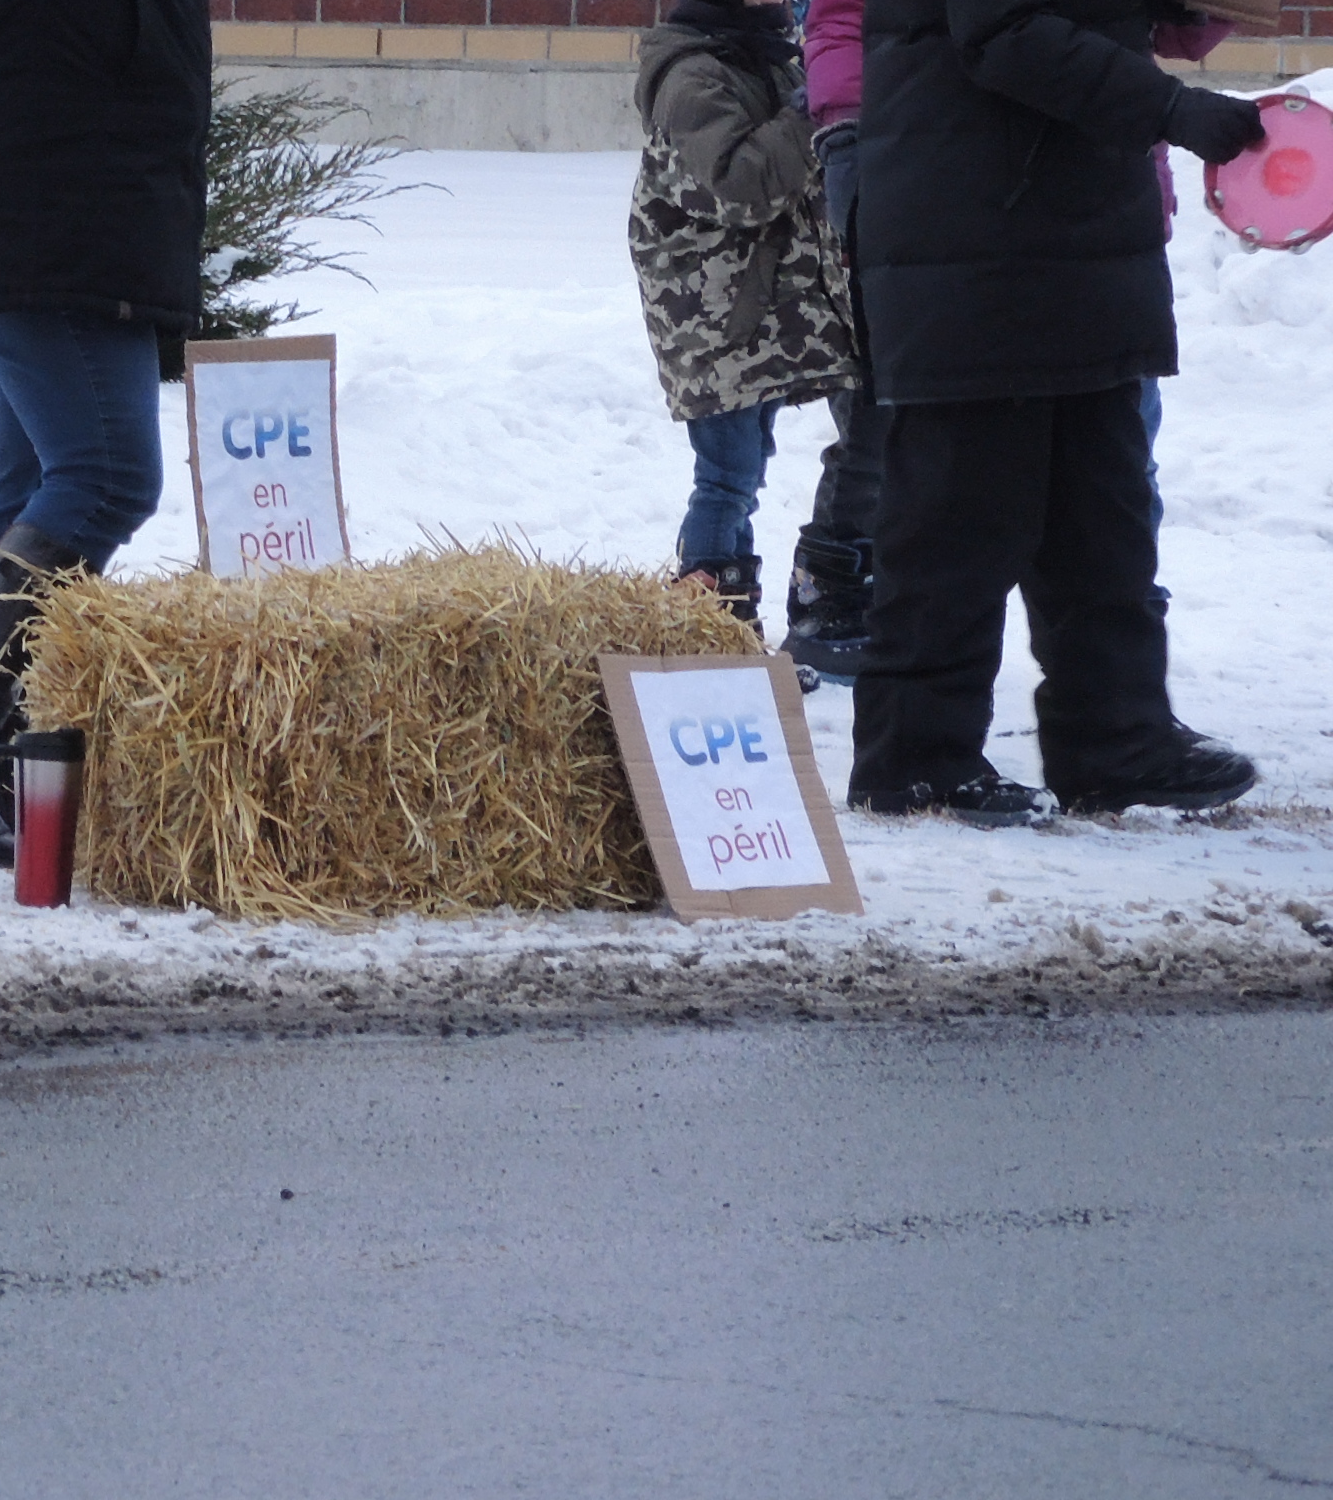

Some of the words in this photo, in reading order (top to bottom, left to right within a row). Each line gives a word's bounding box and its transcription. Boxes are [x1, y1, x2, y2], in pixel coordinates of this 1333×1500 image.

[222, 410, 313, 460] CPE
[253, 482, 288, 509] en
[240, 518, 316, 576] péril
[669, 715, 769, 766] CPE
[715, 787, 753, 811] en
[707, 819, 792, 875] péril
